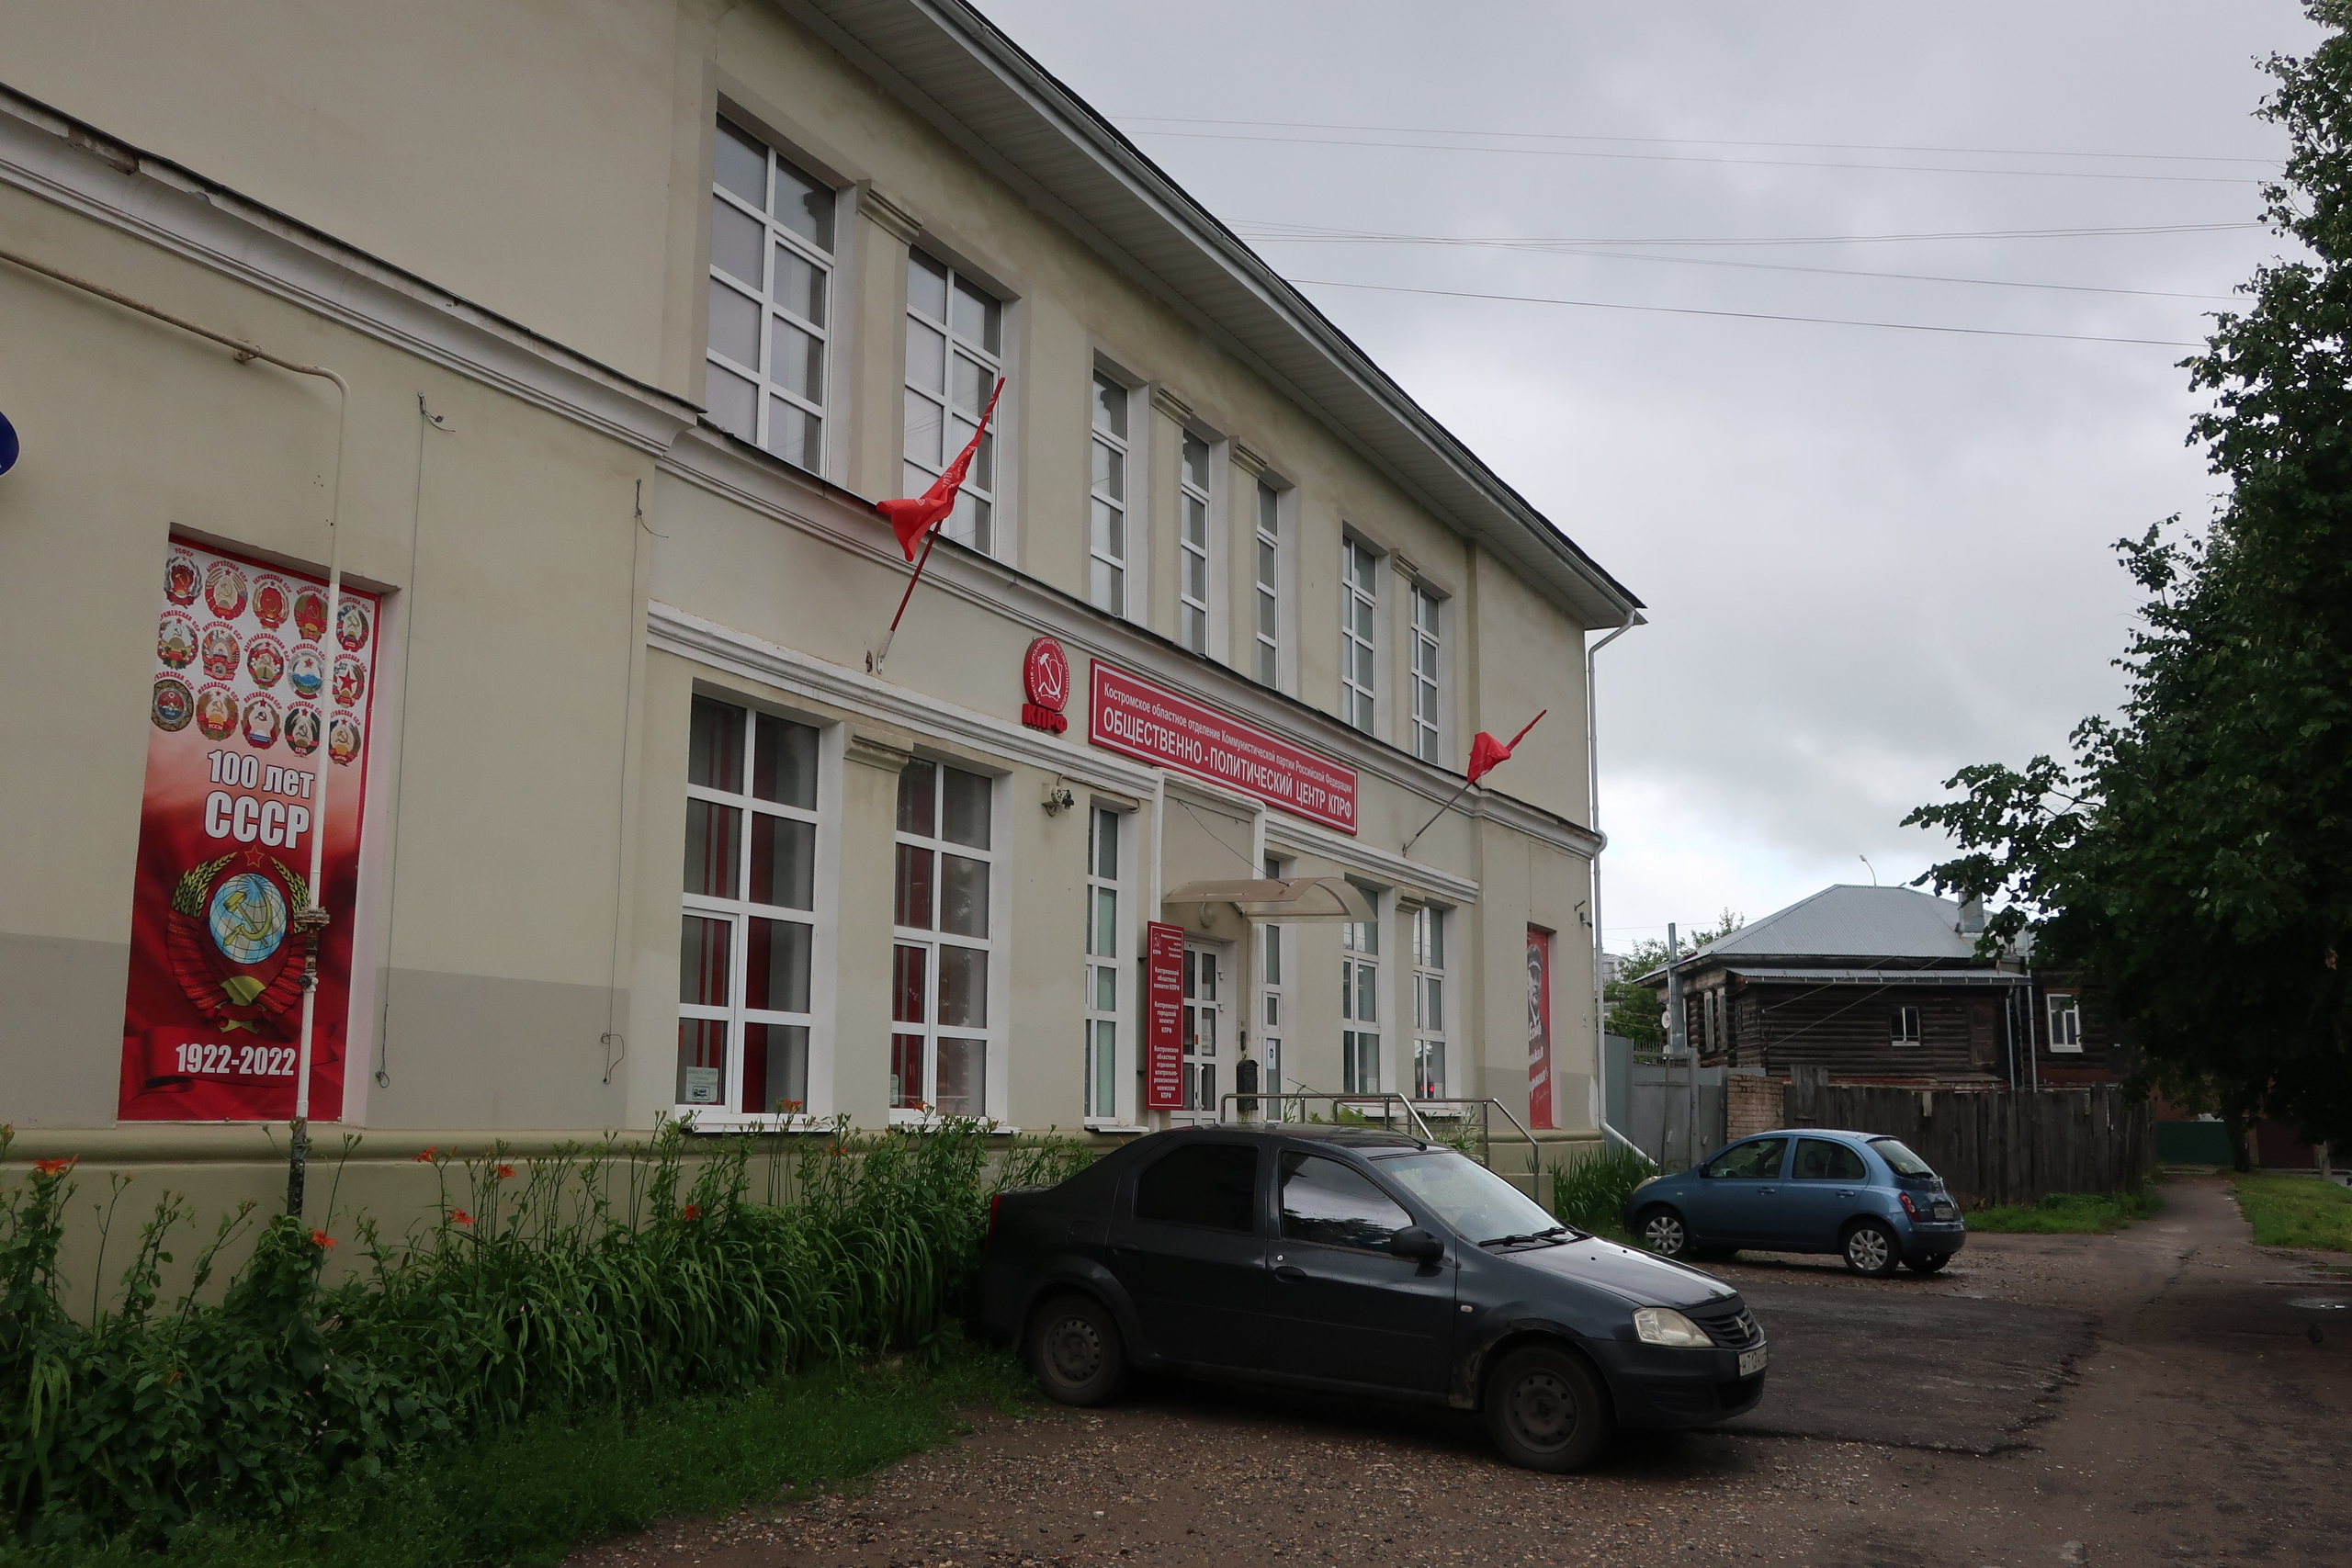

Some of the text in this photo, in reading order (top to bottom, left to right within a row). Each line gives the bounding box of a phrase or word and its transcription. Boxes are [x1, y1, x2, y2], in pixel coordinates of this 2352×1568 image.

[1023, 704, 1068, 733] КПРФ
[1104, 682, 1352, 795] Костромское областное отделение Коммунистической партии Российской Федерации
[208, 750, 314, 798] 100 лет
[204, 790, 310, 849] СССР
[1296, 781, 1326, 809] ЦЕНТР
[1329, 794, 1351, 819] КПРФ
[176, 1043, 296, 1075] 1922-2022
